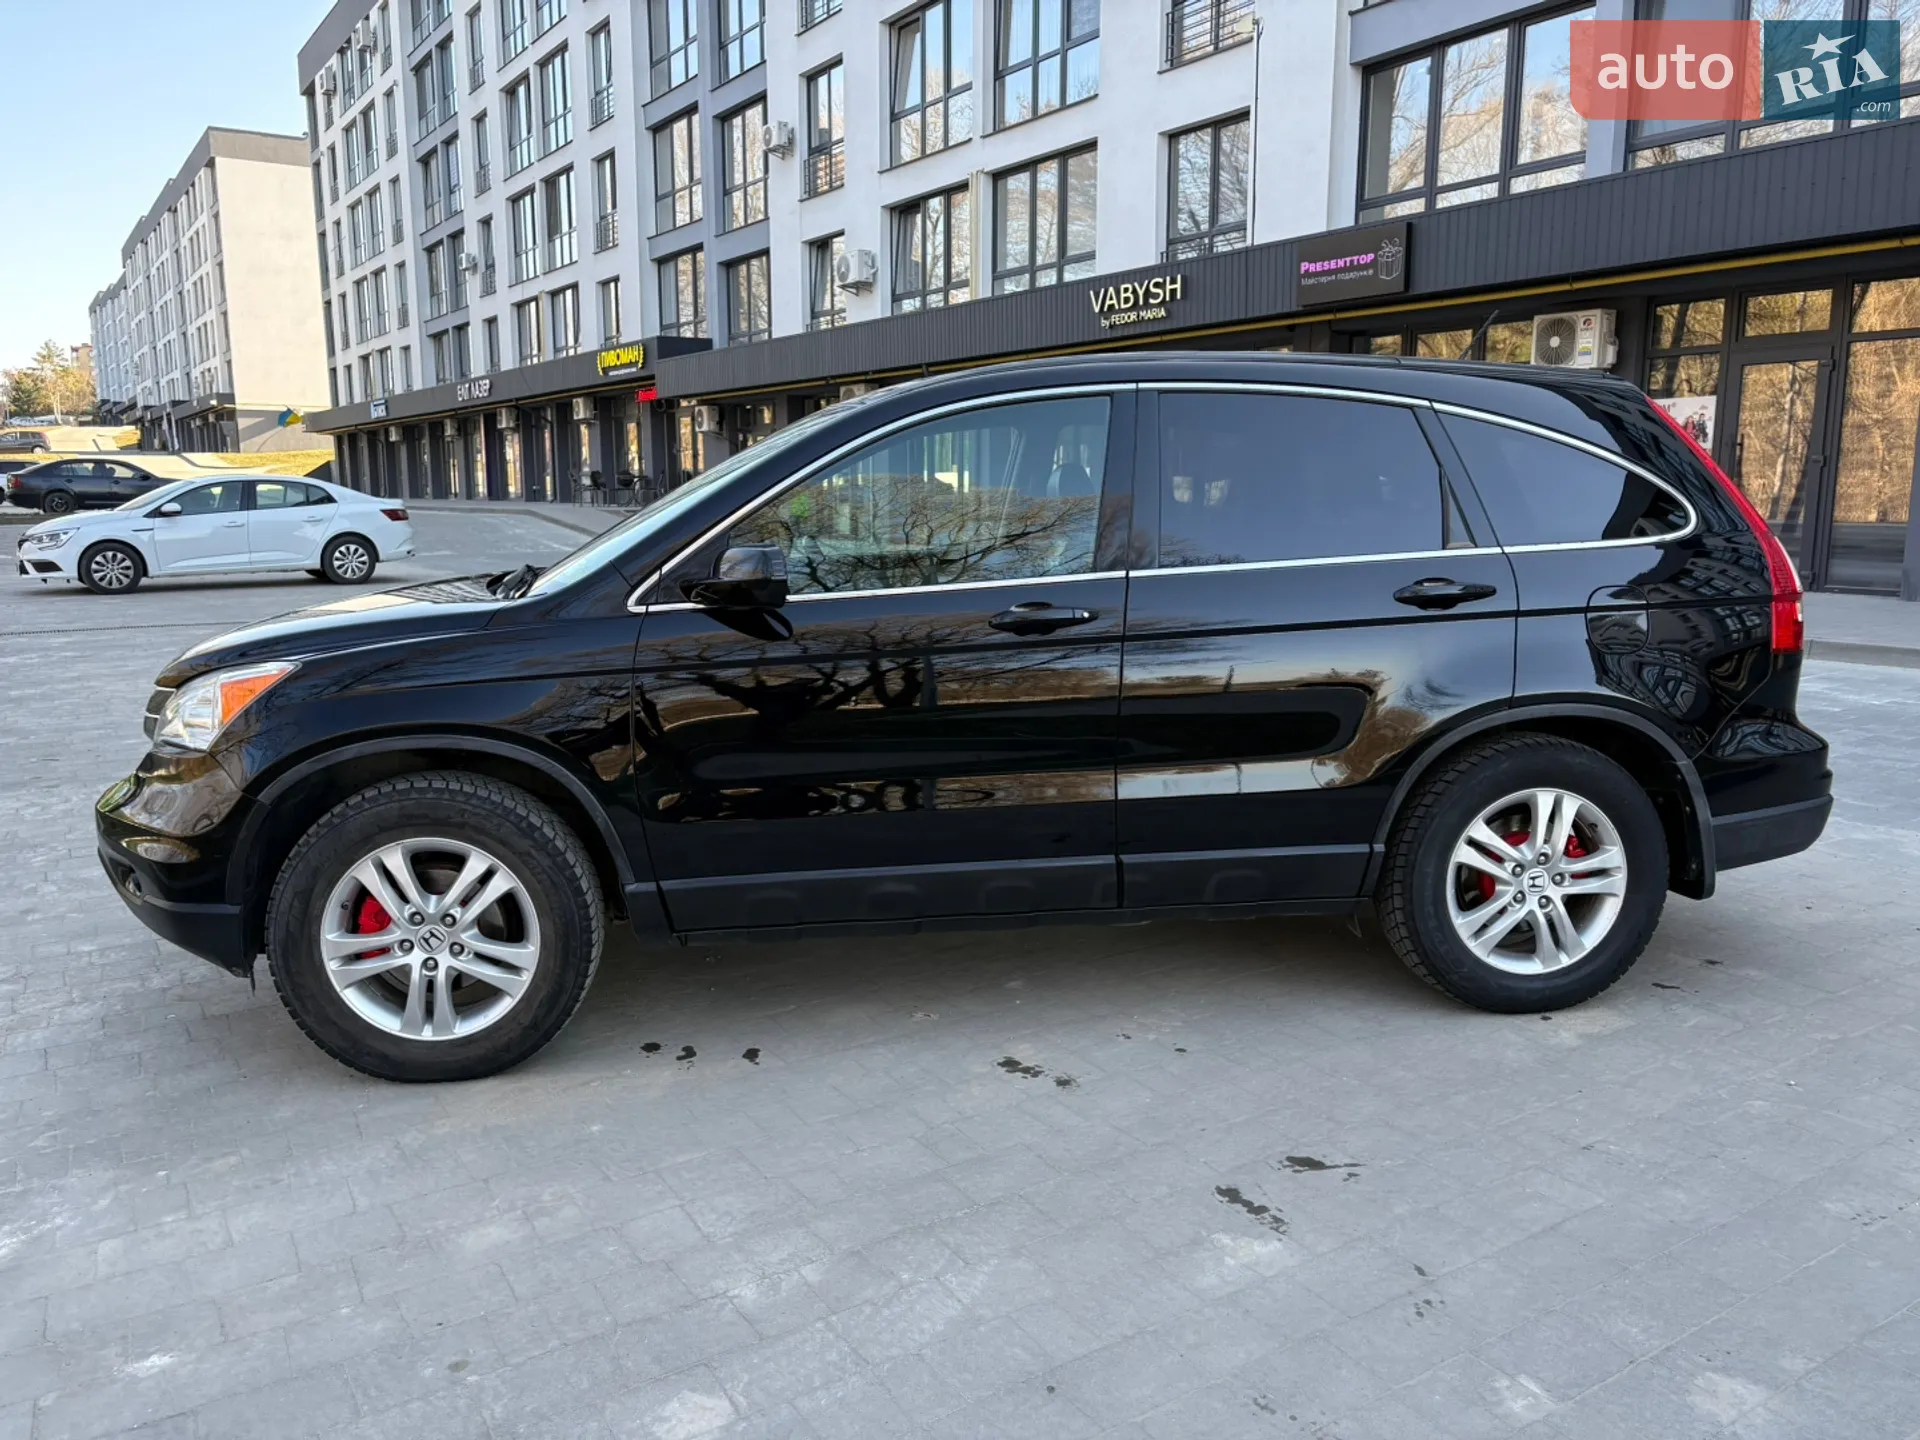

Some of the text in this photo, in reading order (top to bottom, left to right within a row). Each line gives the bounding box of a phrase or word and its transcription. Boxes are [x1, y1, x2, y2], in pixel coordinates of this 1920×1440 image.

[1089, 273, 1181, 313] VABYSH
[1100, 306, 1167, 329] by FEDOR MARIA
[601, 344, 639, 368] ПИВОМАН
